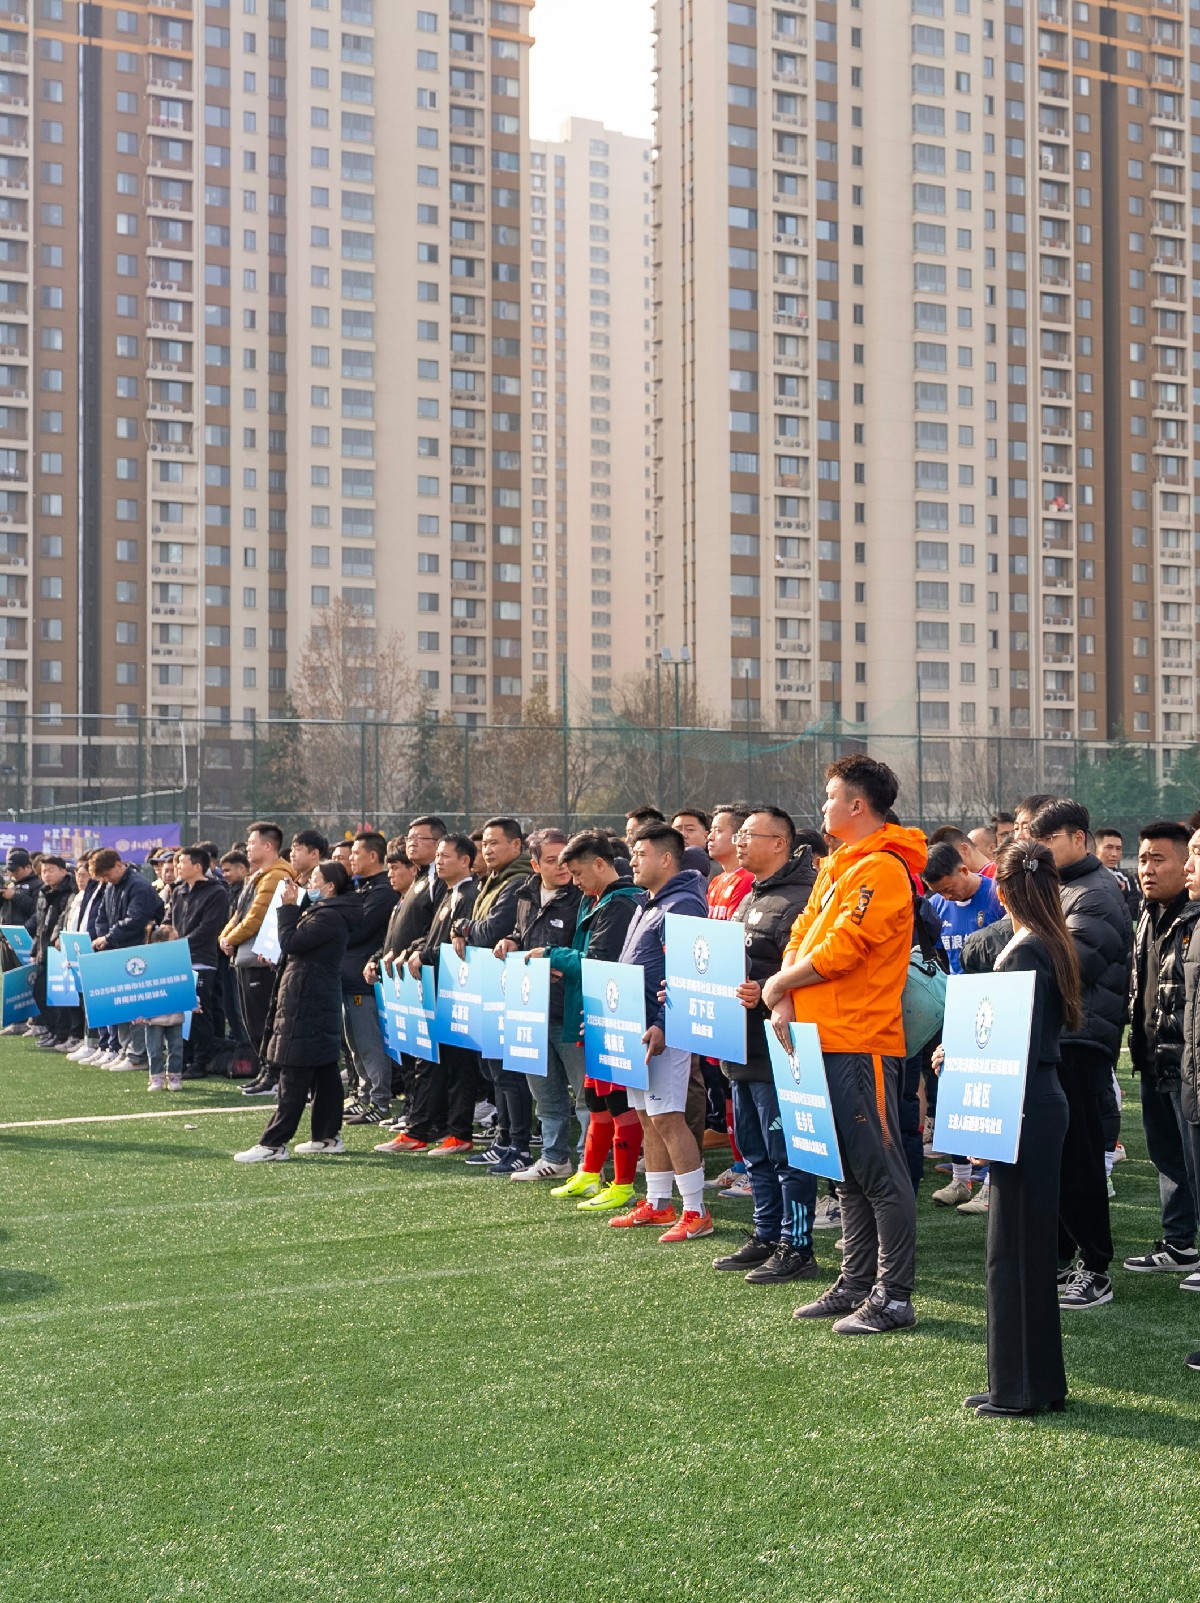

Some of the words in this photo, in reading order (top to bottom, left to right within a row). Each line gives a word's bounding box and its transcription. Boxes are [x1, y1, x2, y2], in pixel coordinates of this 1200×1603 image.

[689, 998, 716, 1020] 历下区
[962, 1081, 992, 1109] 历城区
